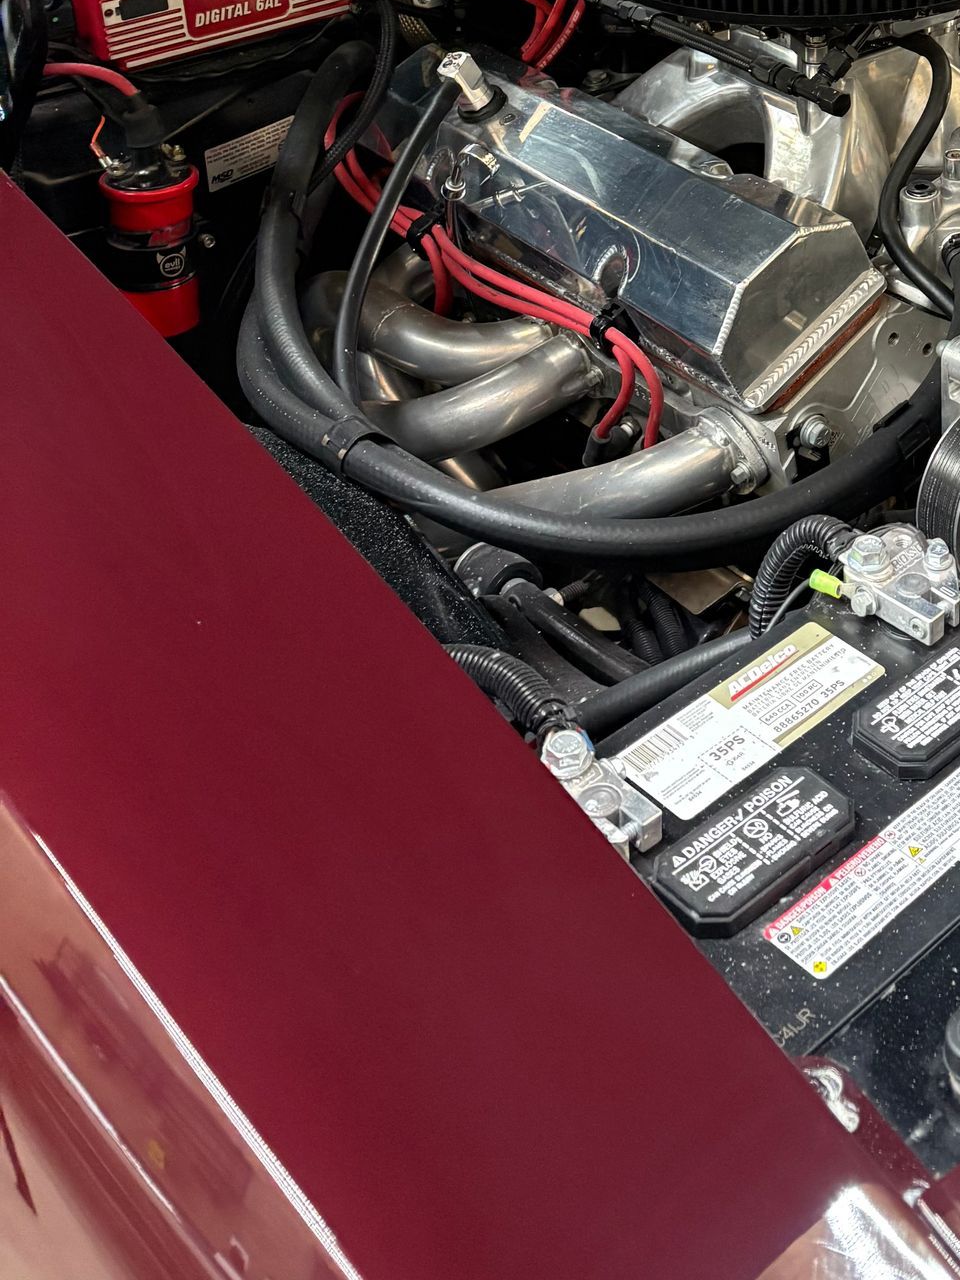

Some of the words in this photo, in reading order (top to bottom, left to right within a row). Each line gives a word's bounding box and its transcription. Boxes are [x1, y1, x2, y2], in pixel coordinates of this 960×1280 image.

[195, 3, 252, 28] DIGITAL
[727, 644, 797, 696] ACDelco
[772, 697, 820, 733] 88865270
[819, 678, 845, 698] 35PS
[776, 702, 791, 714] CCA
[707, 733, 746, 762] 35PS
[742, 774, 794, 813] POISON
[810, 789, 829, 804] ACID
[758, 831, 774, 844] NO
